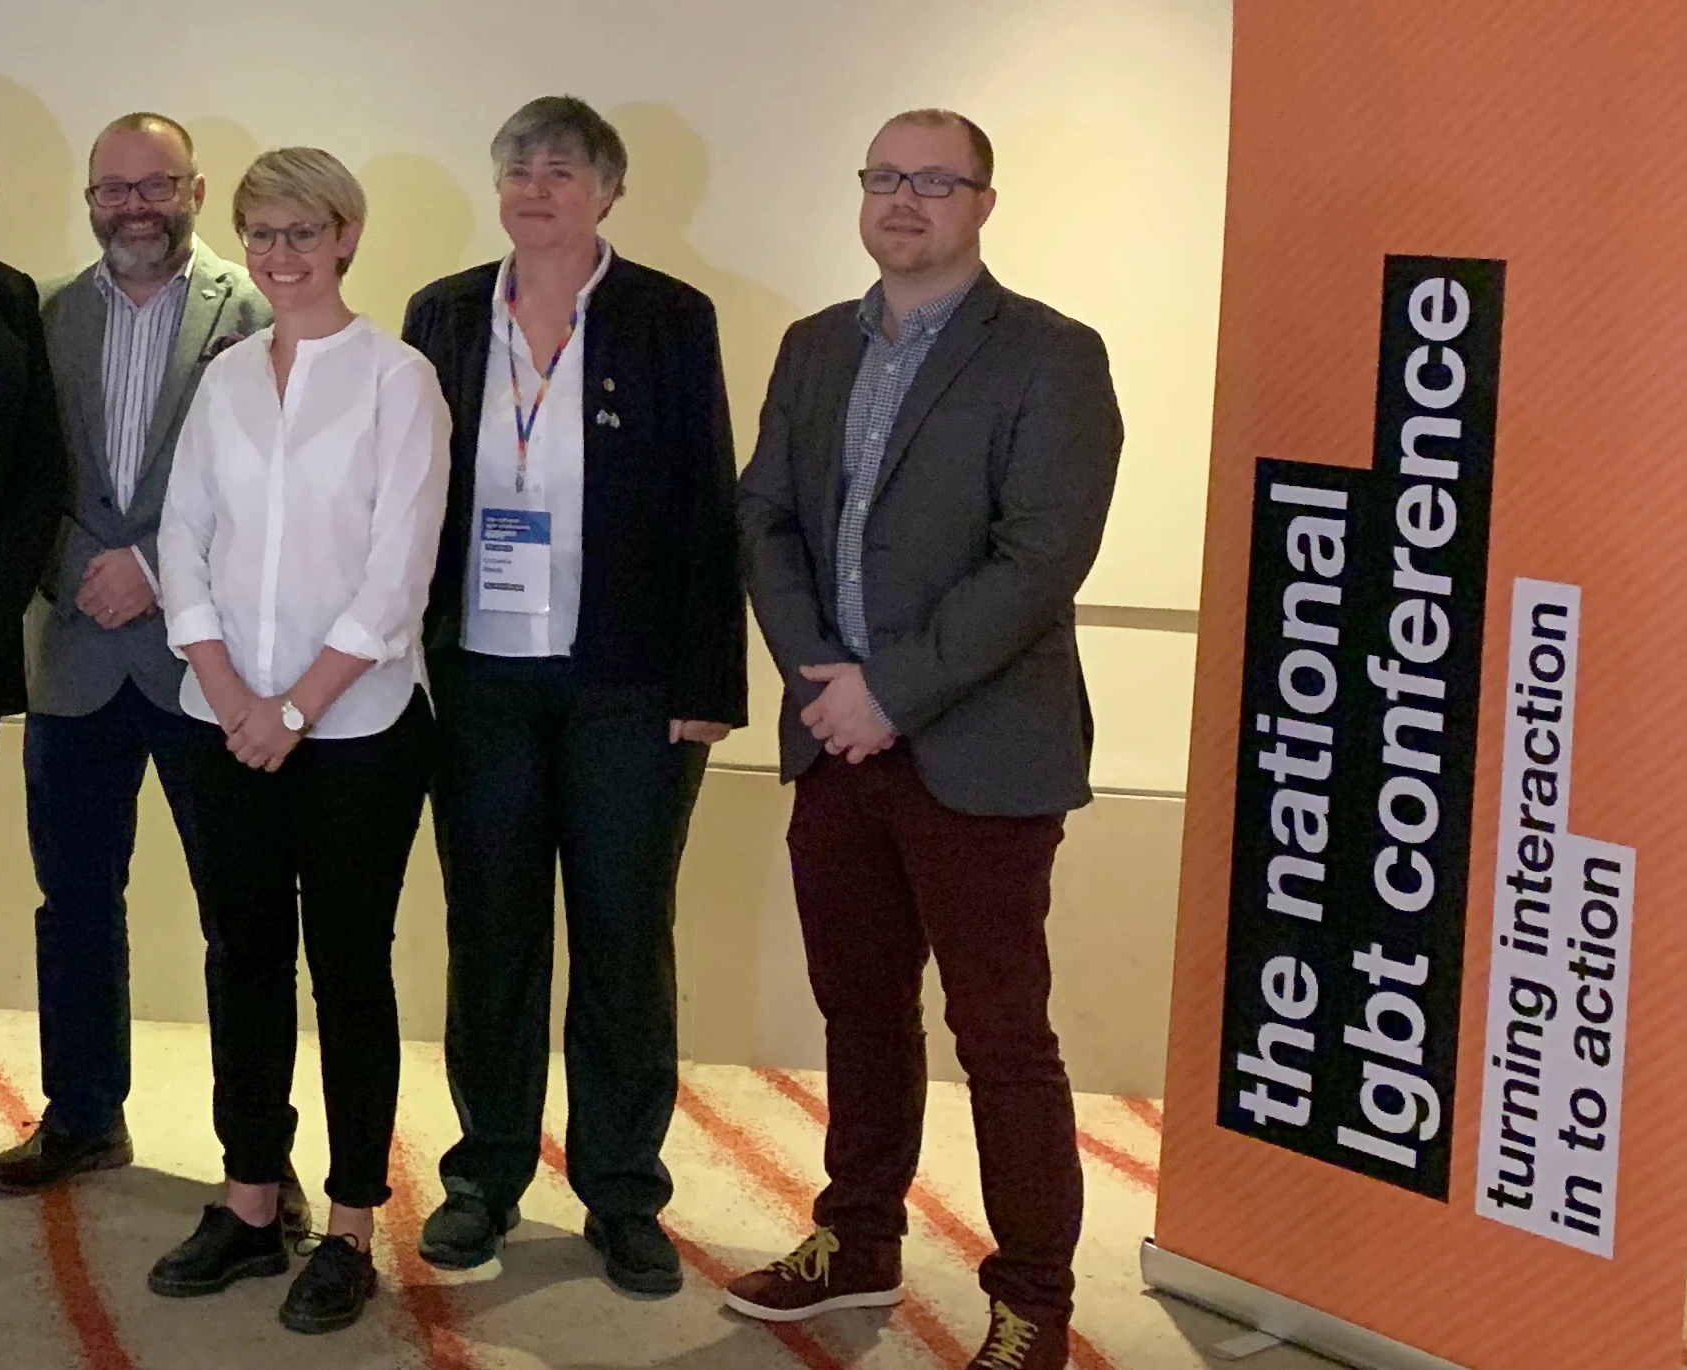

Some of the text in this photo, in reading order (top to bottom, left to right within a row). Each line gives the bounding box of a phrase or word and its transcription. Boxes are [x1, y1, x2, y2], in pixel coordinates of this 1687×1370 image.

[1237, 483, 1349, 1127] the national
[1336, 278, 1471, 1169] lgbt conference
[1487, 603, 1568, 1210] turning interaction
[1550, 857, 1621, 1237] in to action
